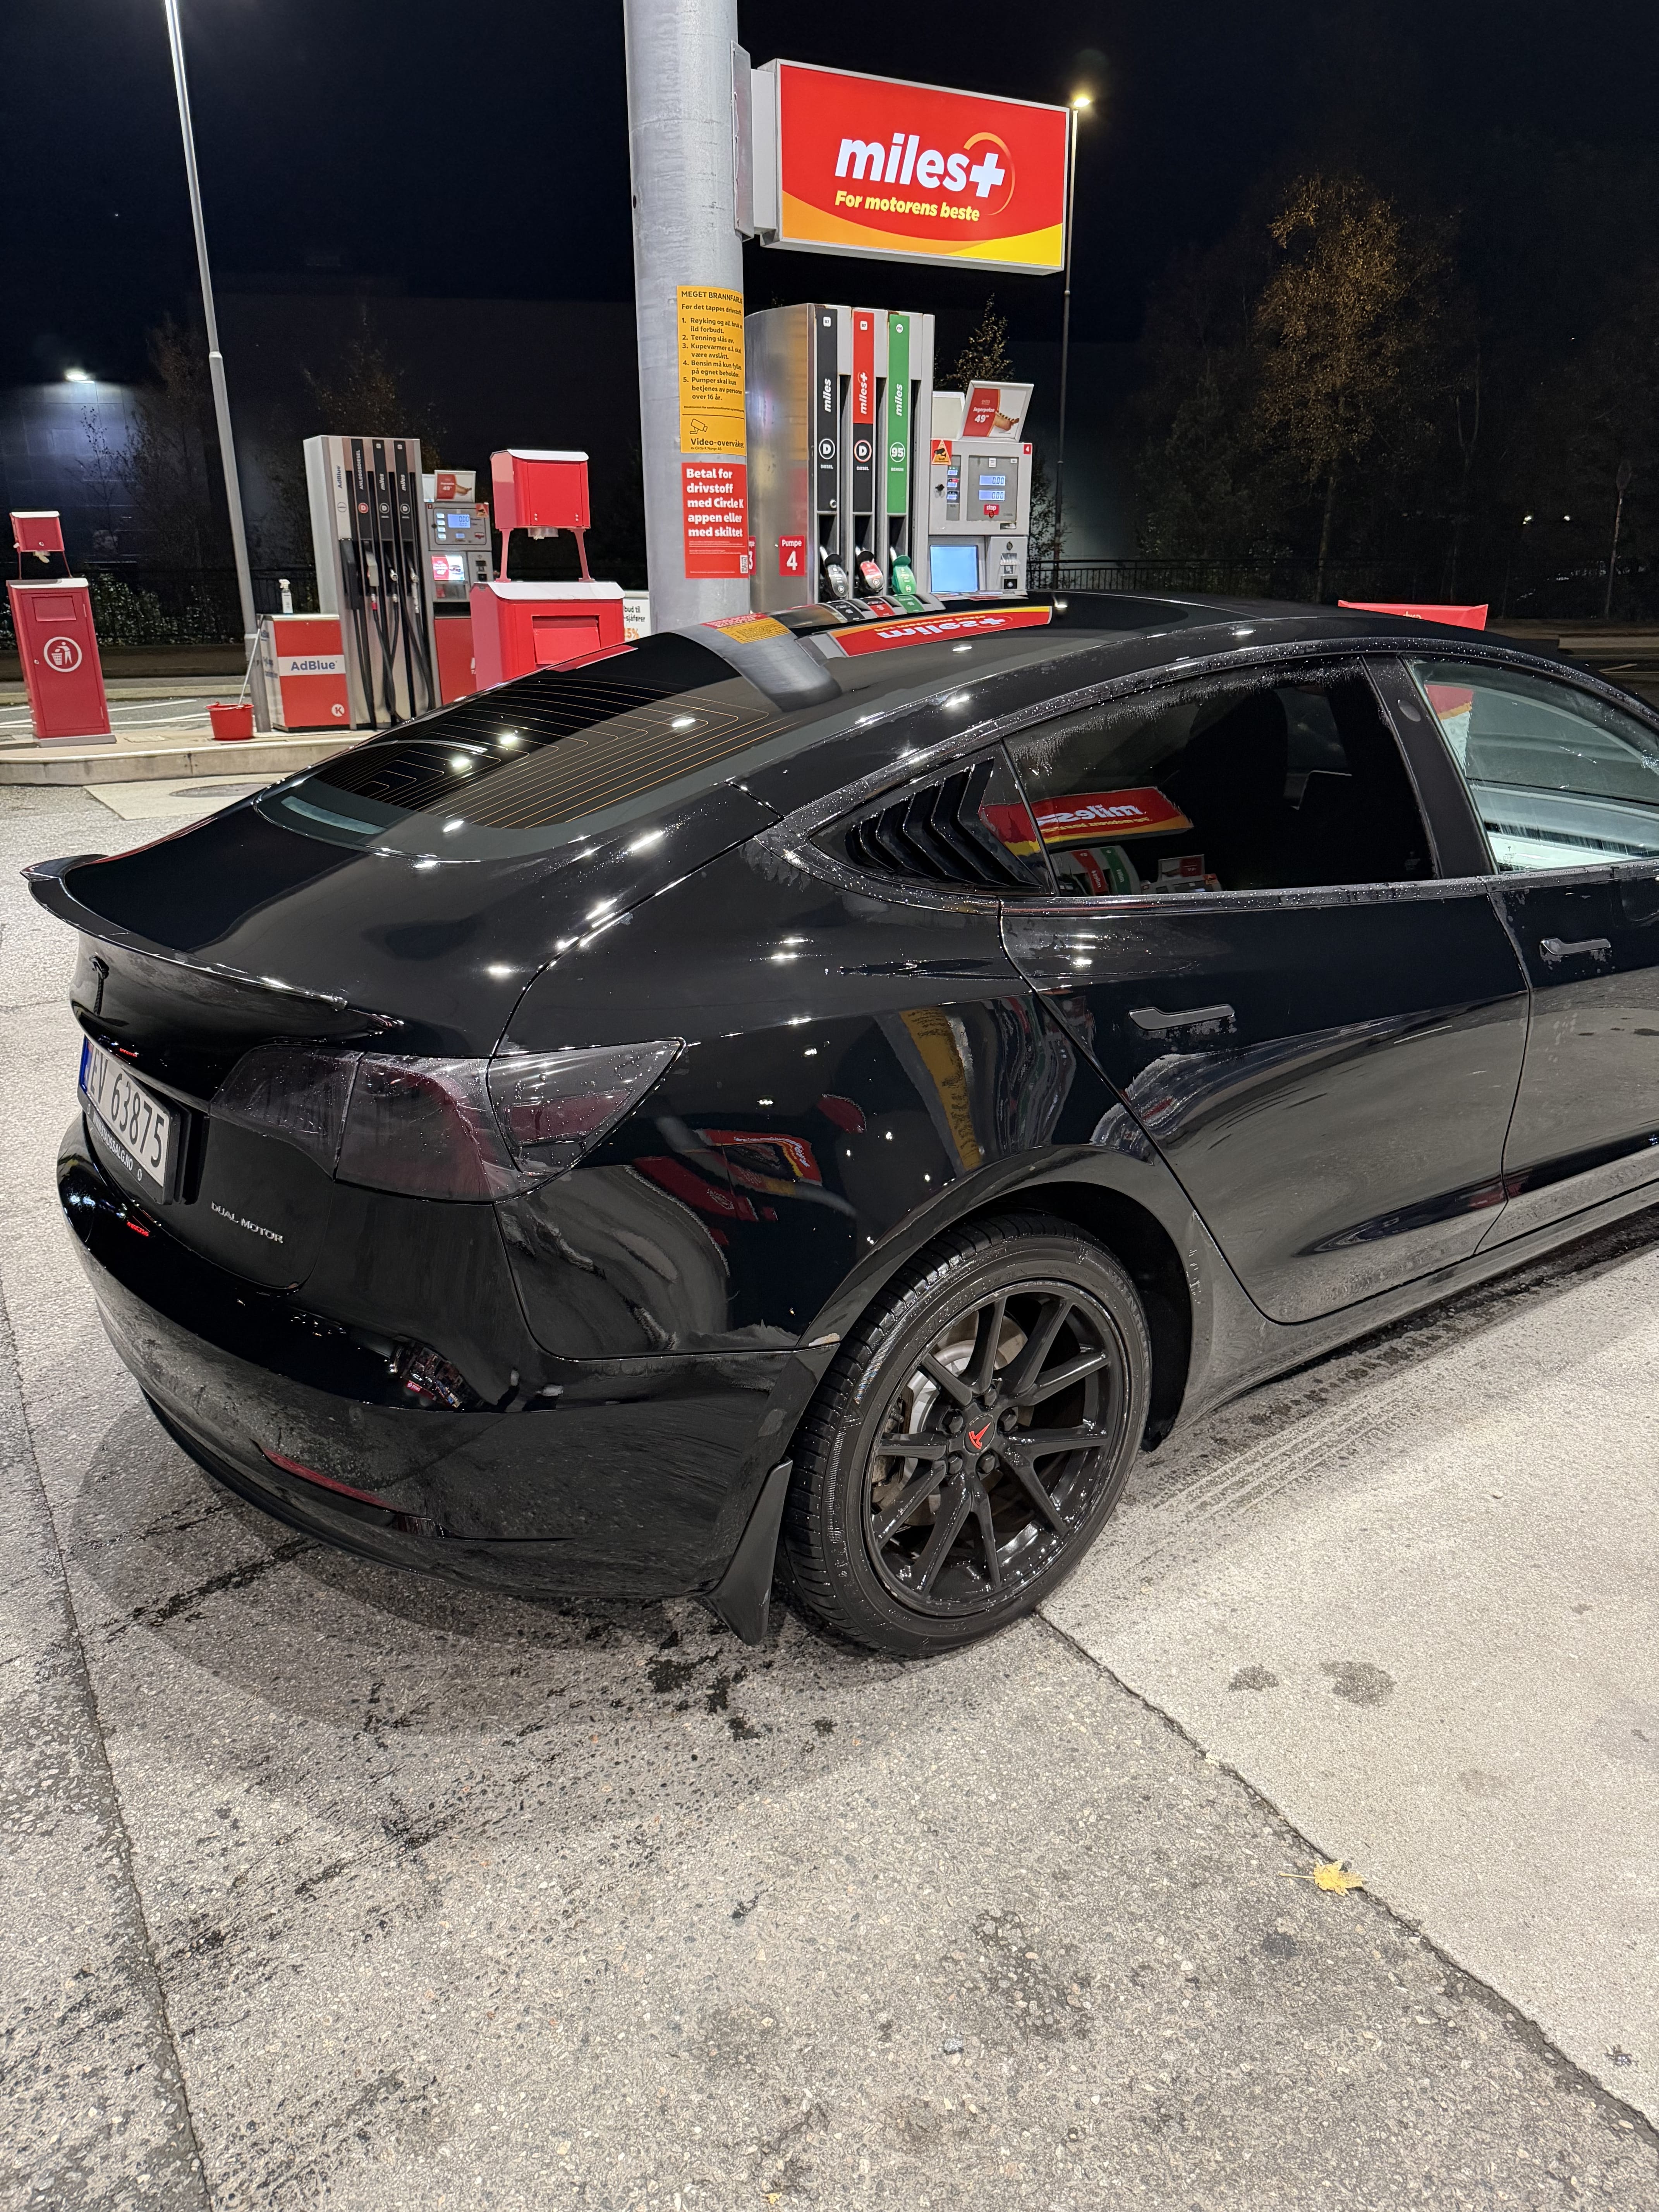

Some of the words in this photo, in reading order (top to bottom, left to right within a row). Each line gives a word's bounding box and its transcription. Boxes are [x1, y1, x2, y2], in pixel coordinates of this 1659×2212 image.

[835, 132, 1005, 198] miles+
[835, 190, 862, 209] For
[864, 196, 937, 217] motorens
[939, 203, 980, 222] beste
[690, 318, 716, 326] Røyking
[691, 335, 716, 343] Tenning
[691, 343, 727, 351] Kupevarmer
[691, 367, 700, 376] på
[691, 377, 716, 385] Pumper
[692, 385, 718, 393] betjenes
[823, 443, 831, 455] D
[859, 445, 867, 456] D
[891, 447, 905, 458] 95
[686, 468, 717, 479] Betal
[718, 469, 733, 479] for
[687, 482, 734, 494] drivstoff
[687, 497, 713, 508] med
[714, 497, 738, 508] Circle
[739, 498, 744, 509] K
[688, 515, 723, 525] appen
[723, 512, 742, 523] eller
[688, 527, 713, 538] med
[714, 527, 743, 538] skiltet
[781, 539, 802, 548] Pumpe
[787, 551, 798, 571] 4
[291, 660, 335, 671] AdBlue
[90, 1048, 108, 1104] EV
[111, 1073, 165, 1168] 63875
[211, 1201, 239, 1223] DUAL
[241, 1218, 283, 1243] MOTOR
